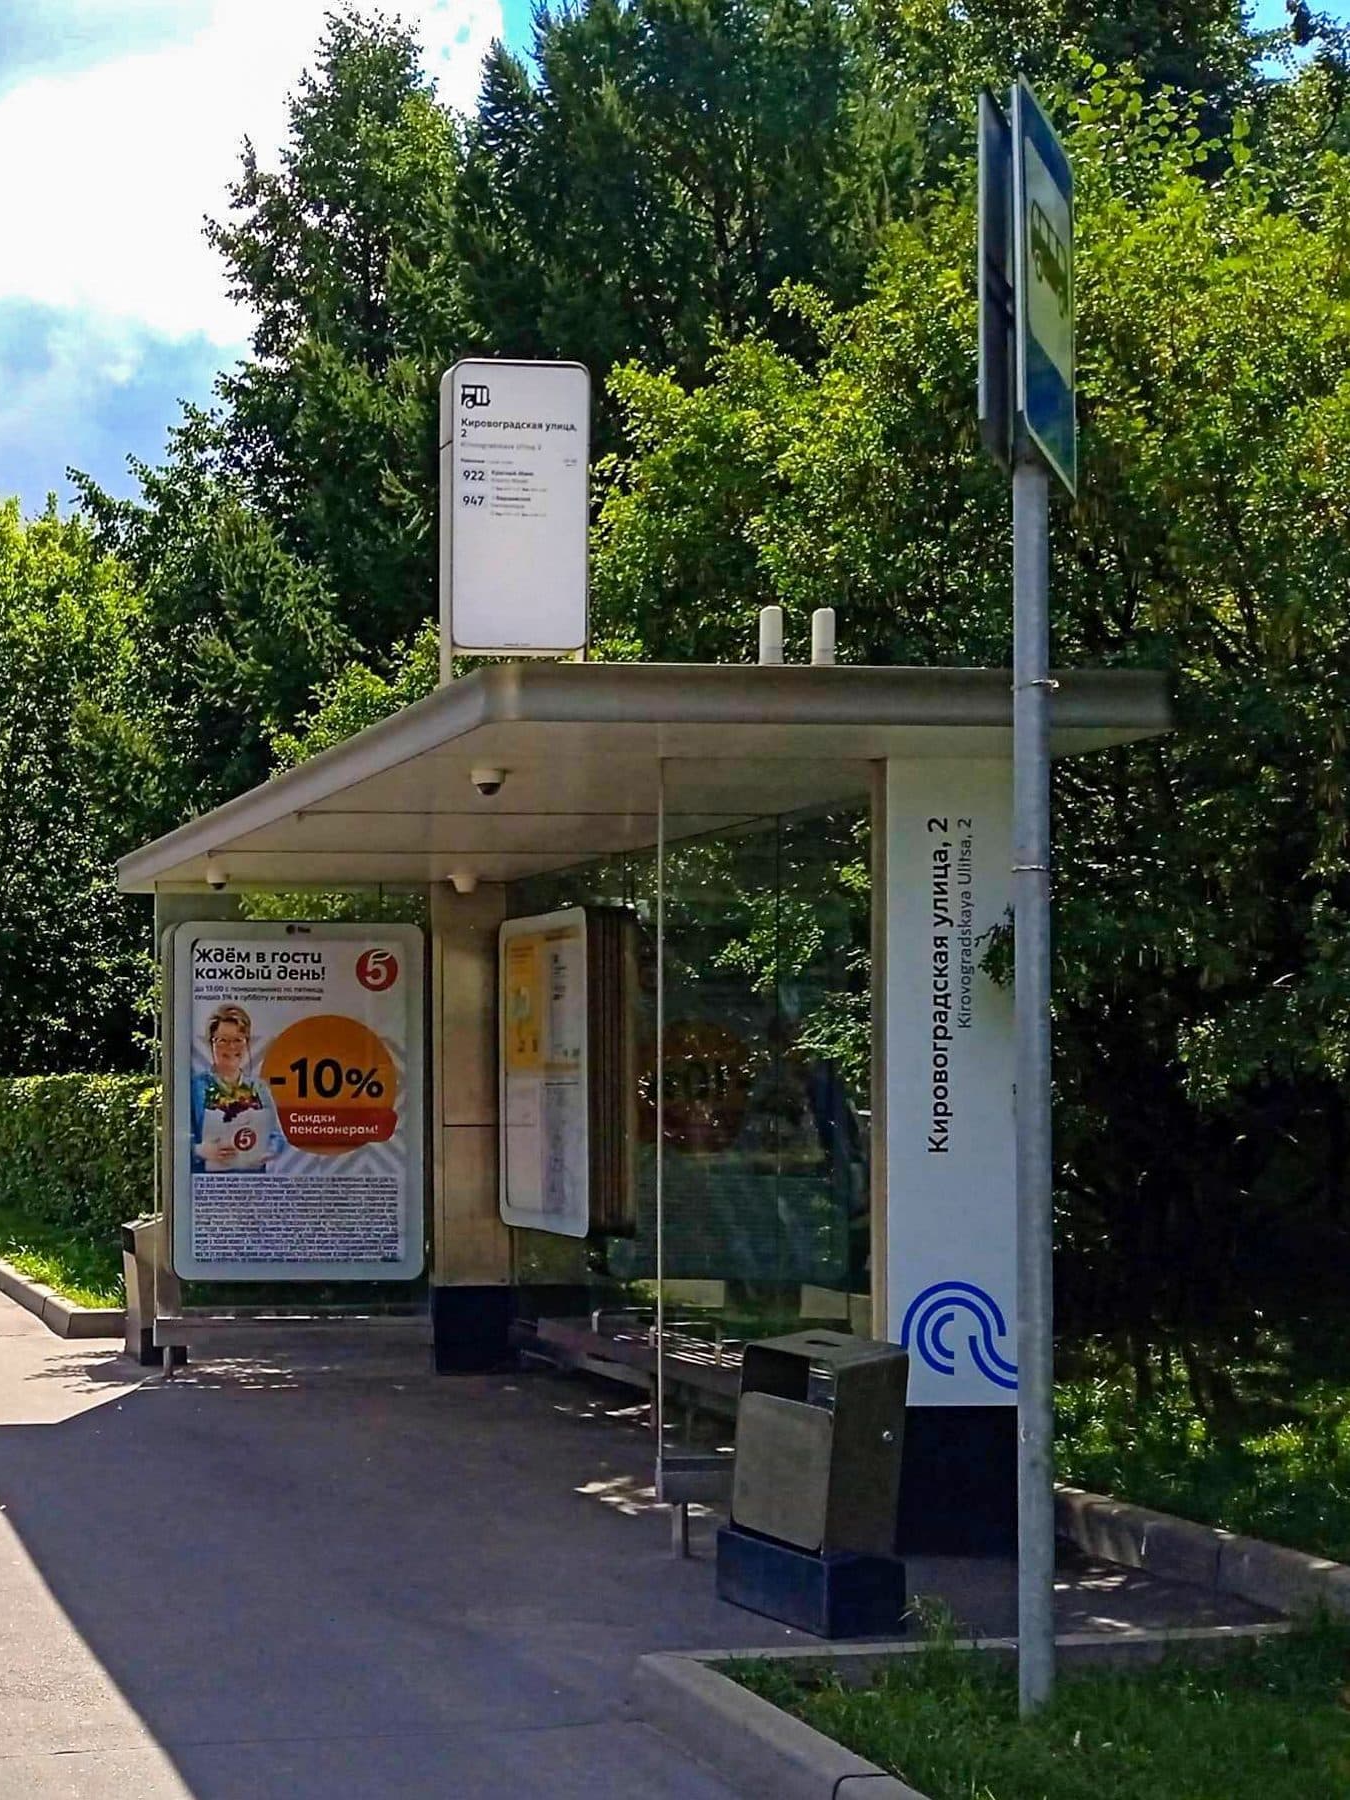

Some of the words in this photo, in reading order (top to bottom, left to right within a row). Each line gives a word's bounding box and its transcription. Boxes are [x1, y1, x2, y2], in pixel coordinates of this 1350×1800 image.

[461, 418, 543, 430] Кировоградская
[545, 422, 577, 432] улица,
[461, 429, 467, 438] 2
[463, 470, 485, 481] 922
[463, 495, 485, 506] 947
[928, 817, 949, 833] 2
[958, 818, 973, 829] 2
[957, 834, 973, 885] Ulitsa,
[931, 841, 953, 928] улица,
[195, 947, 250, 963] Ждём
[256, 952, 266, 963] в
[271, 952, 322, 963] гости
[957, 892, 975, 1029] Kirovogradskaya
[195, 965, 271, 980] каждый
[277, 965, 325, 980] день!
[928, 935, 953, 1153] Кировоградская
[270, 1057, 384, 1099] -10%
[289, 1113, 336, 1124] Скидки
[289, 1125, 379, 1137] пенсионерам!
